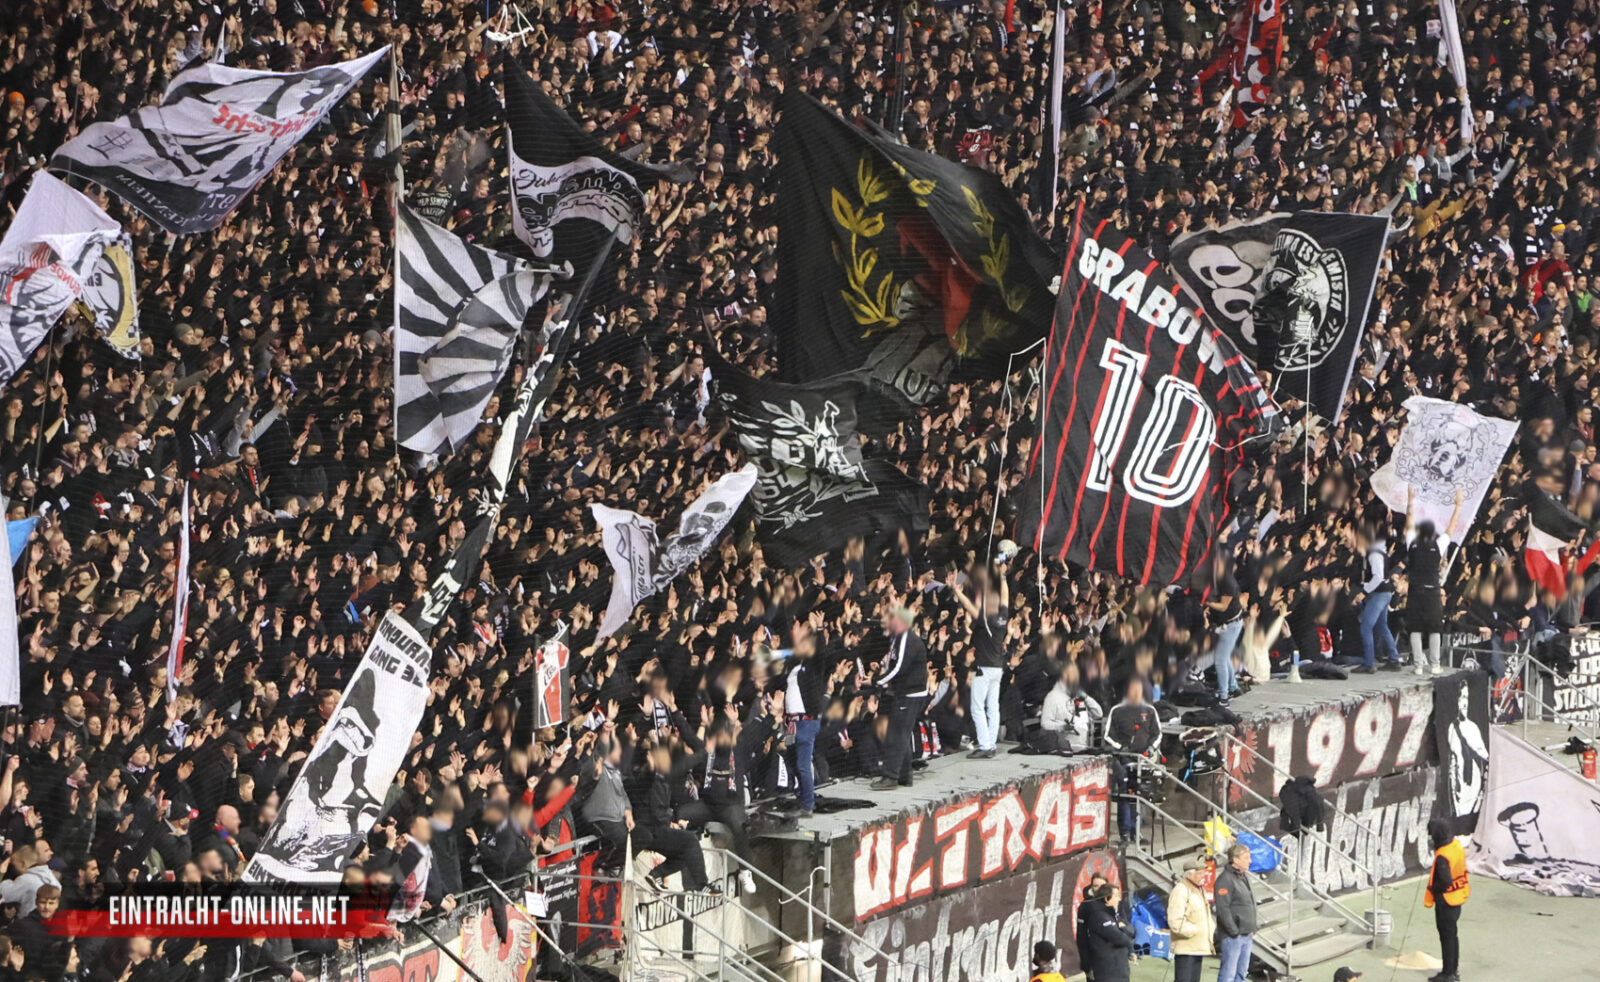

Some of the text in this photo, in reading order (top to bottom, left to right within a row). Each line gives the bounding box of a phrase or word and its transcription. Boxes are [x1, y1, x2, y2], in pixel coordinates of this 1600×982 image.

[1086, 337, 1217, 508] 10
[1267, 683, 1435, 798] 1997
[853, 758, 1112, 924] ULTRAS
